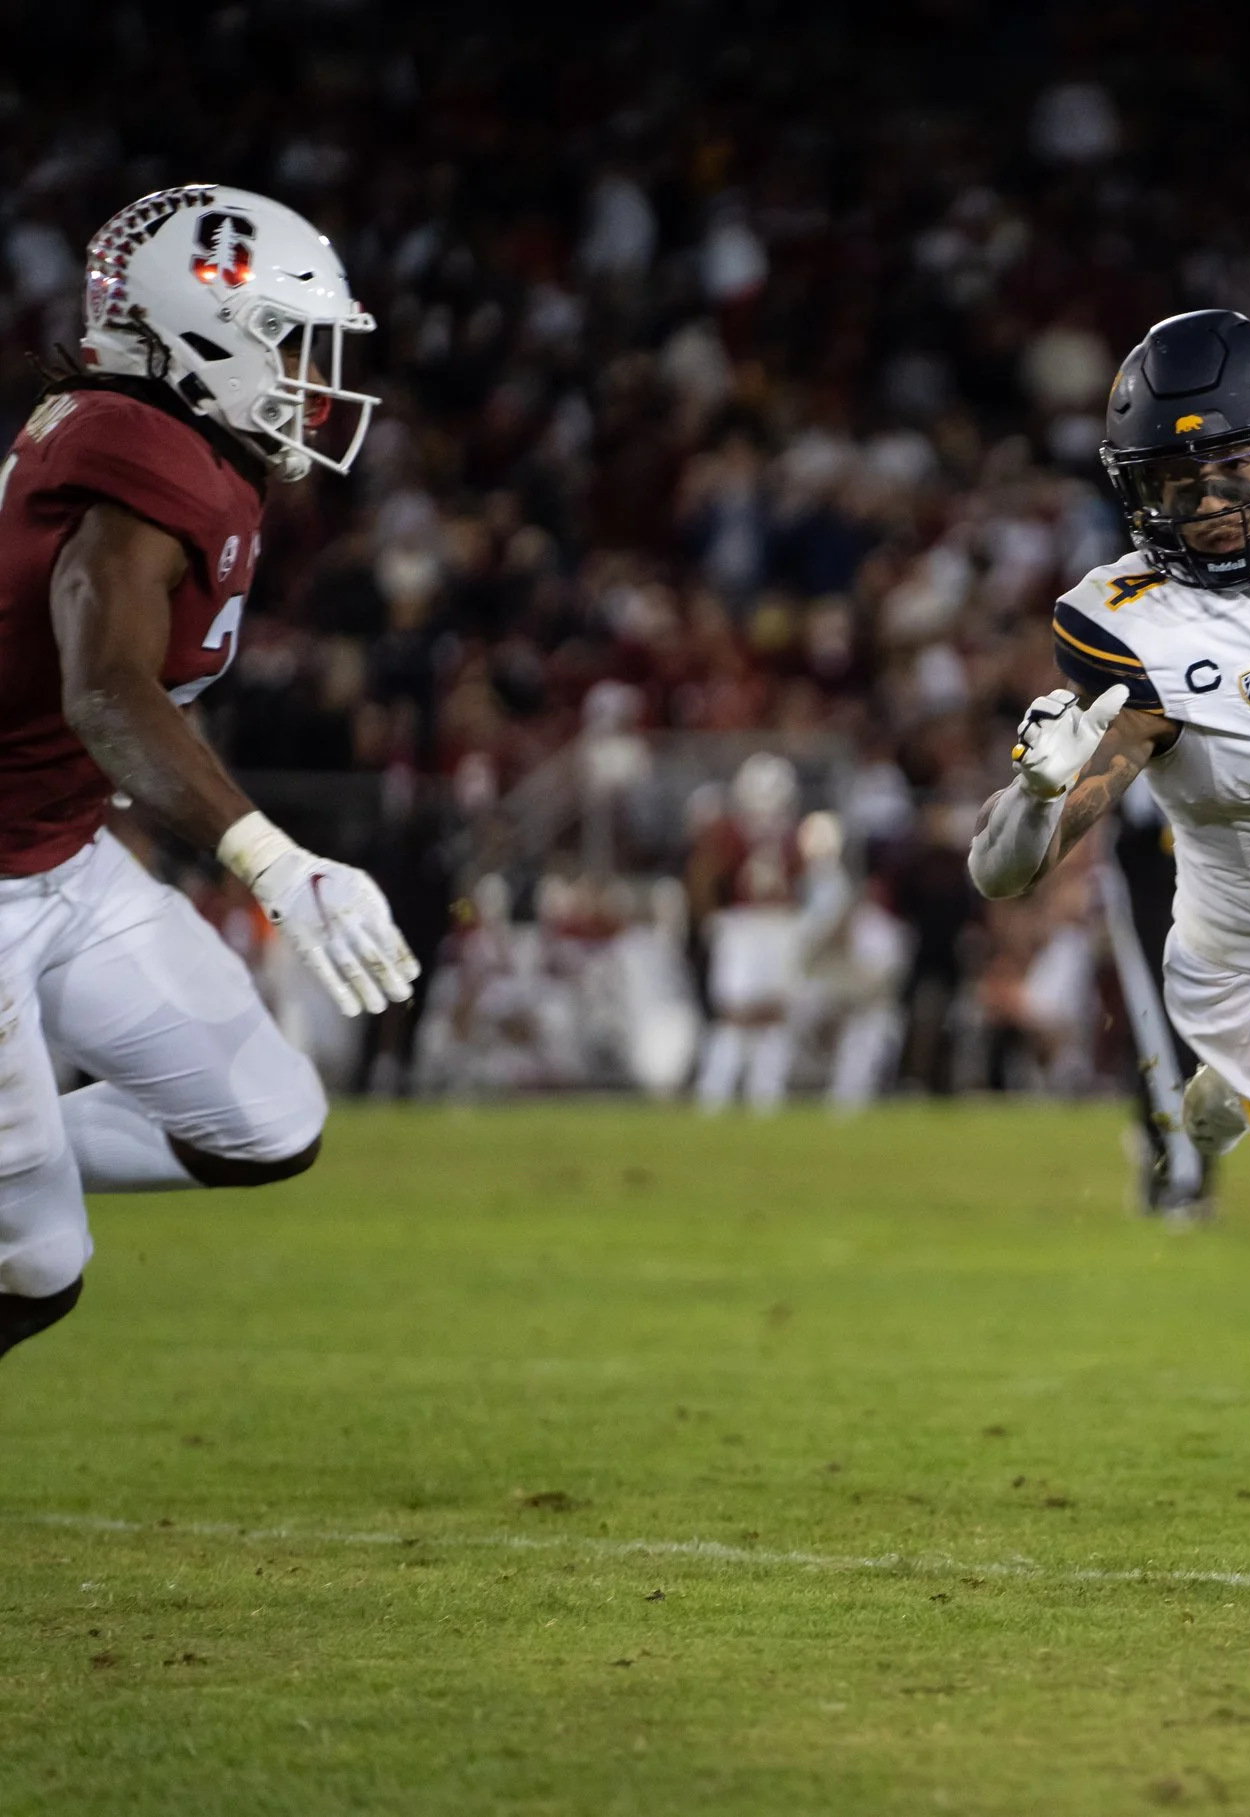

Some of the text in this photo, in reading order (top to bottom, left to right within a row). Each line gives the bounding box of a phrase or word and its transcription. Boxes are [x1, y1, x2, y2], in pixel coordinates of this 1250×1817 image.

[1207, 558, 1247, 573] Riddell
[1104, 570, 1169, 613] 4
[1185, 659, 1222, 694] C
